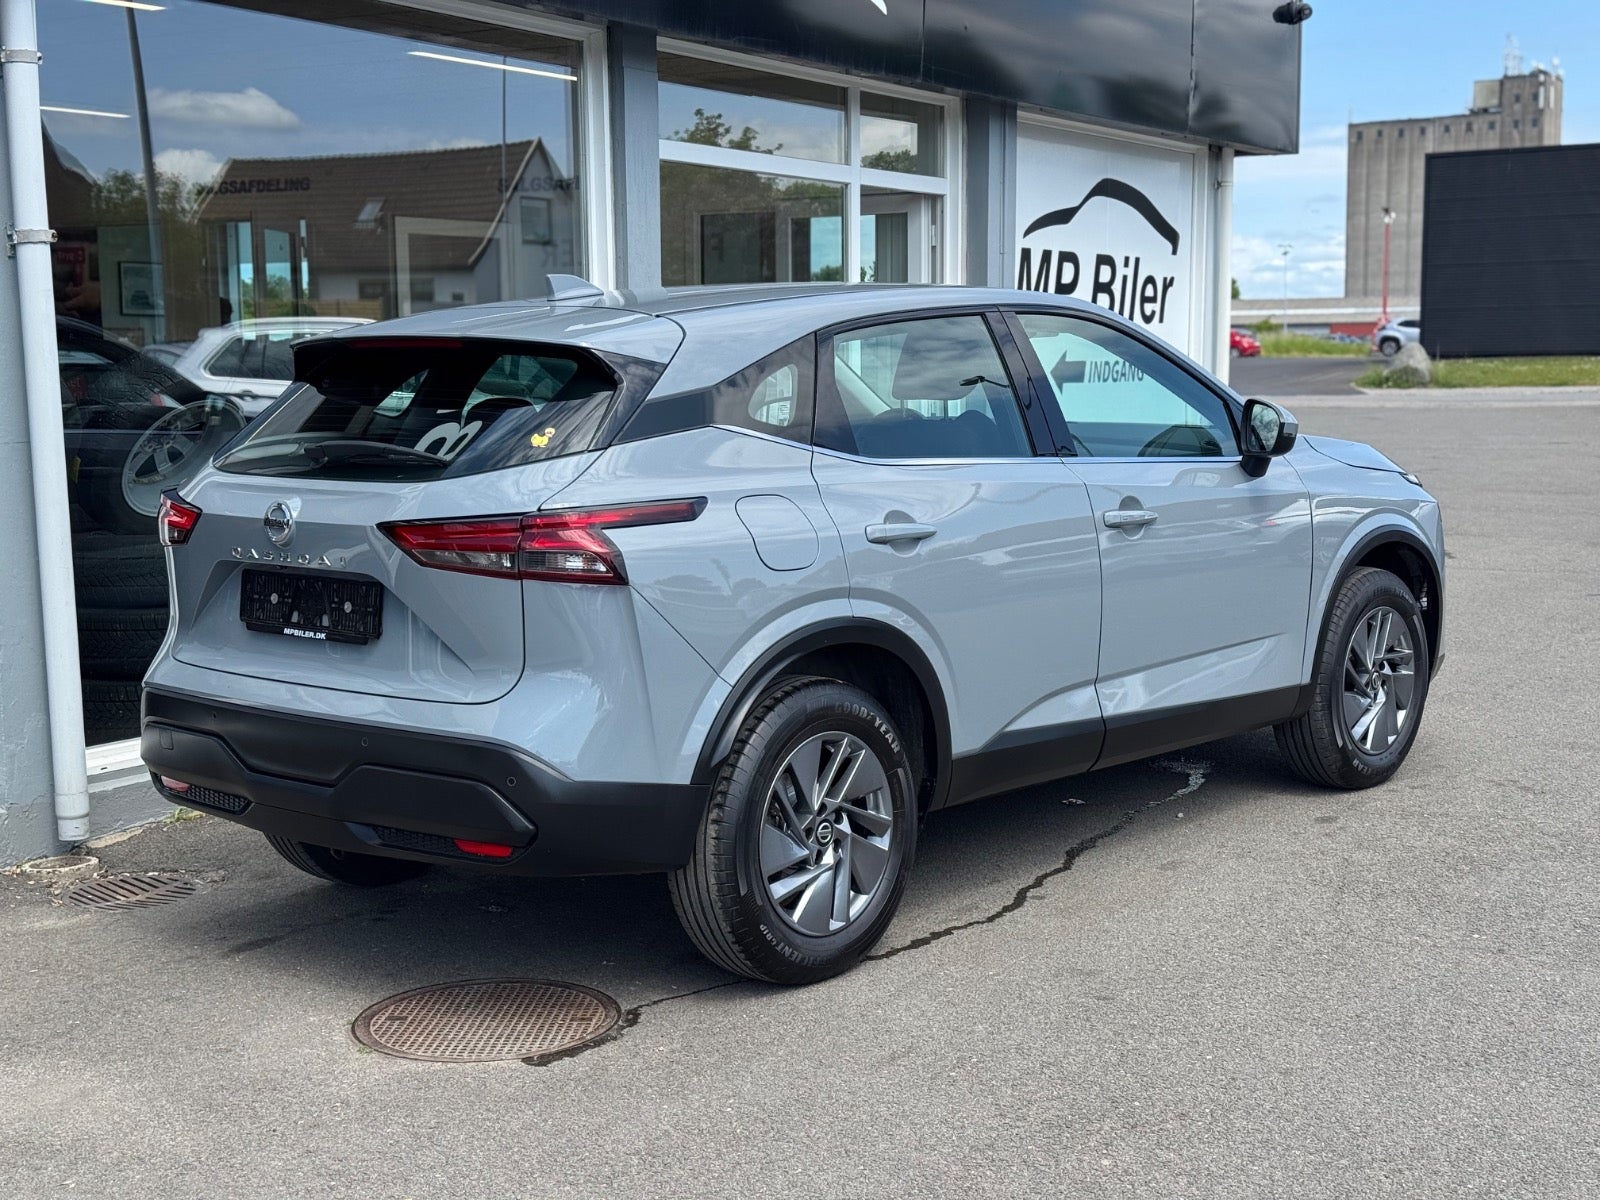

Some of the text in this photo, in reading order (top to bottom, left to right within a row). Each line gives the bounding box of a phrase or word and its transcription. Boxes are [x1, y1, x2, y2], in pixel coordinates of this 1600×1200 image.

[1017, 247, 1175, 325] MP Biler
[231, 546, 347, 565] QASHQAI
[284, 627, 326, 640] MPBILER.DK
